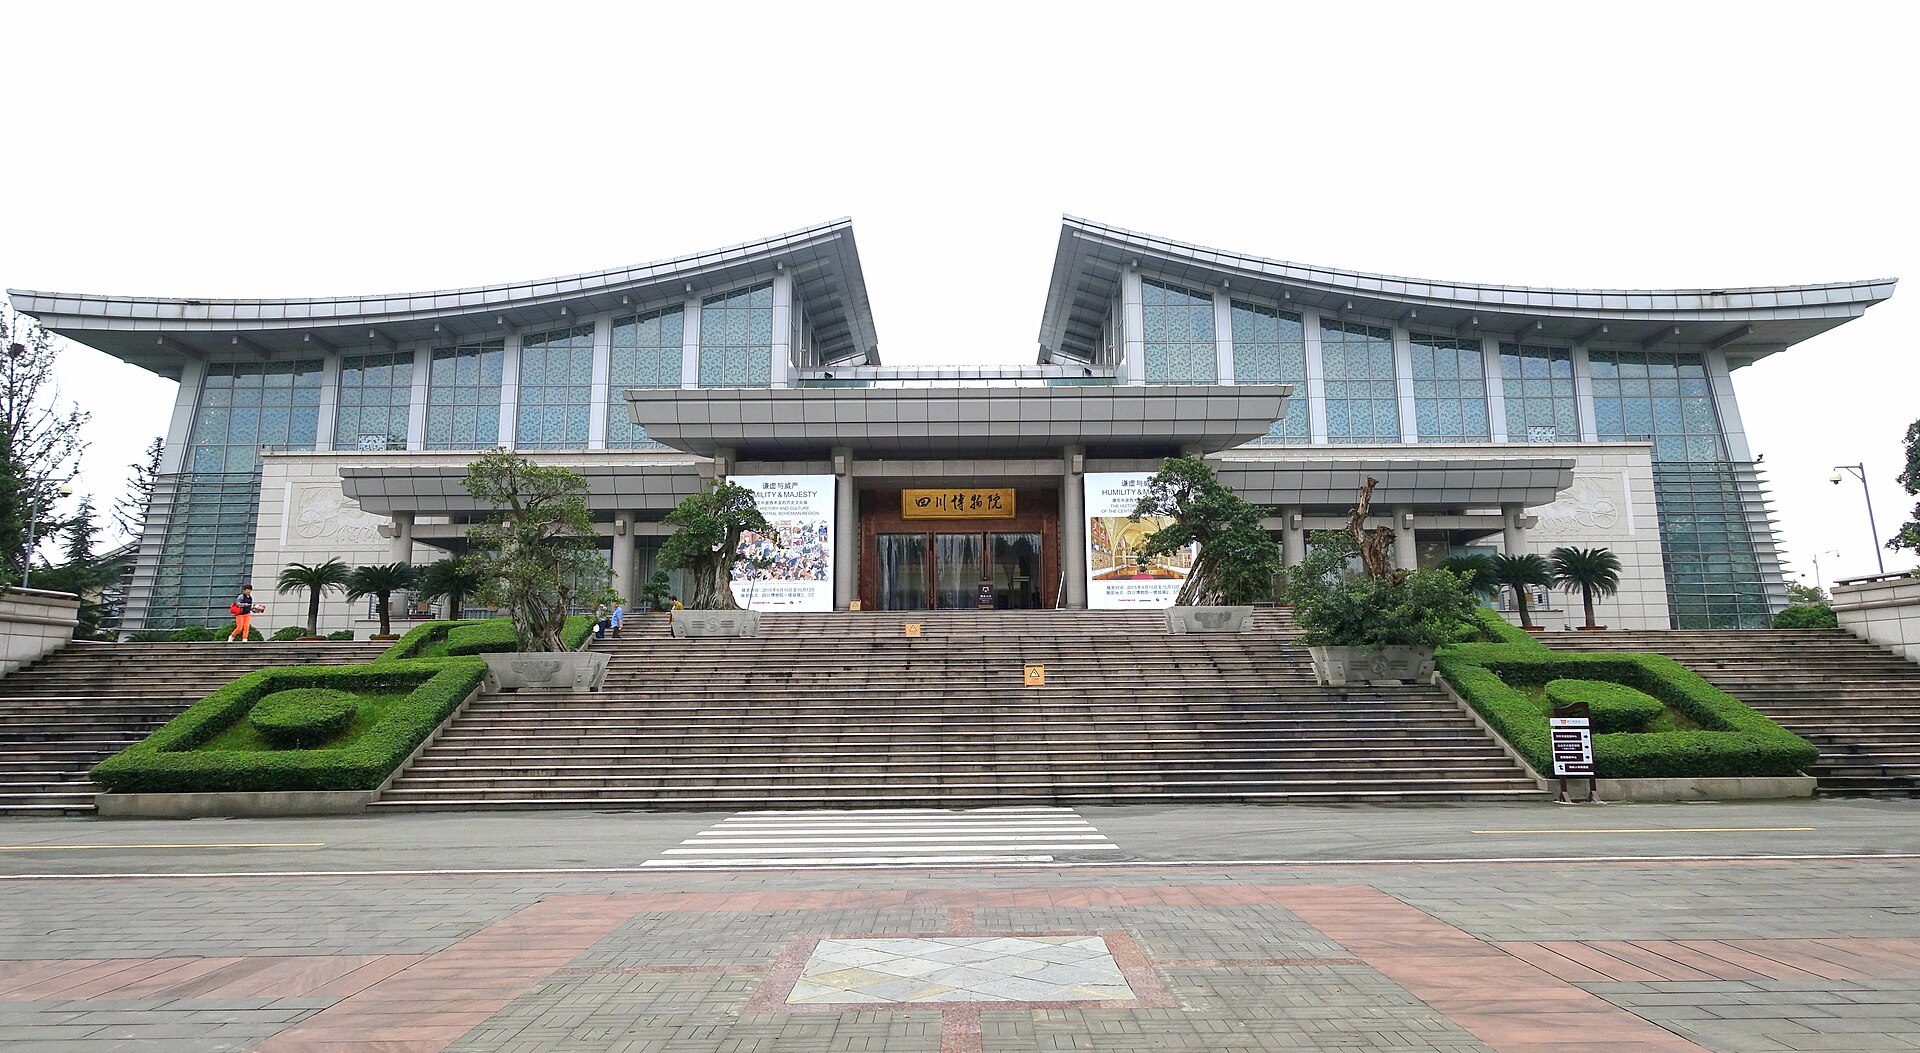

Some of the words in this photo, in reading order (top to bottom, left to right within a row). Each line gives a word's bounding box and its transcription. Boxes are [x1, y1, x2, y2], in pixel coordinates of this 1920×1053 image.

[762, 482, 798, 490] 谦虚与威严
[784, 490, 817, 498] MAJESTY
[915, 493, 1003, 511] 四川博物院
